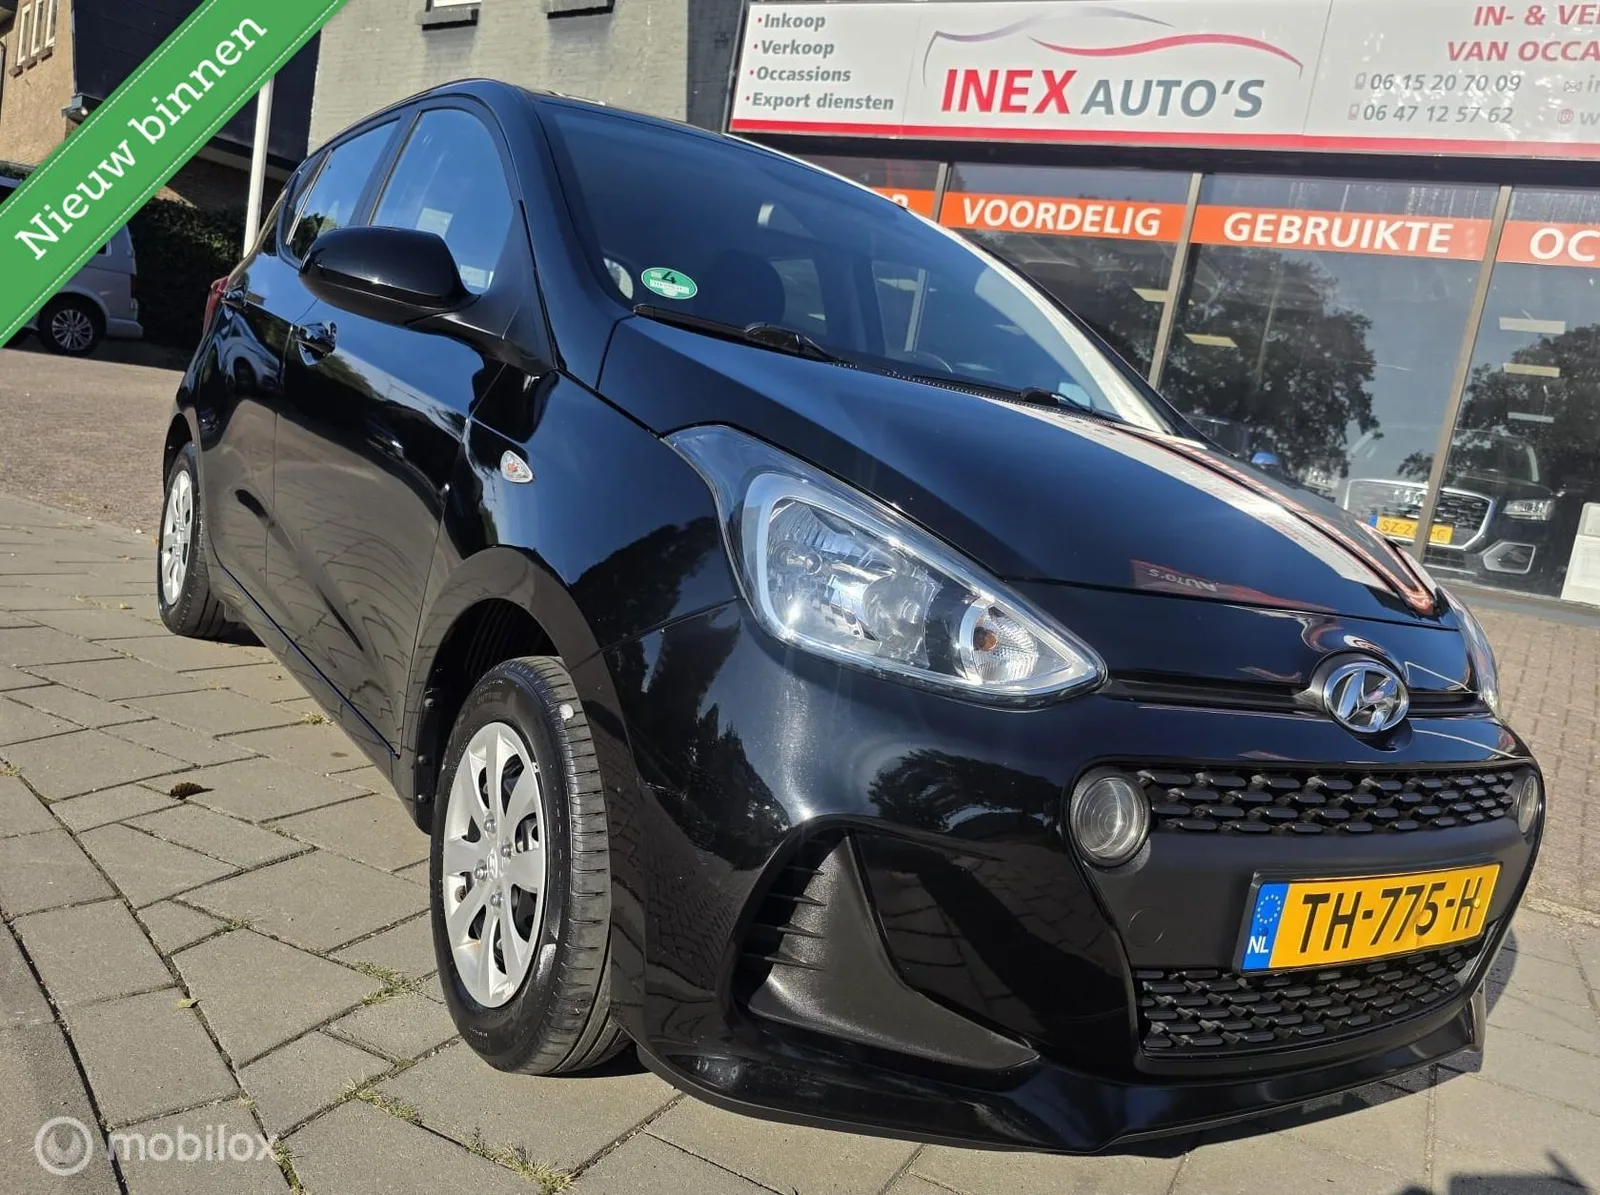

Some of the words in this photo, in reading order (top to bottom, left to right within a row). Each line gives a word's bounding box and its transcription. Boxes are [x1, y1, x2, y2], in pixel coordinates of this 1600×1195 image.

[764, 13, 826, 32] Inkoop
[1473, 6, 1515, 26] IN-
[1524, 5, 1545, 26] &
[1558, 4, 1600, 25] VE
[761, 39, 835, 59] Verkoop
[1447, 41, 1508, 61] VAN
[757, 66, 851, 82] Occassions
[1370, 74, 1394, 90] 06
[1403, 74, 1426, 90] 15
[1431, 75, 1456, 91] 20
[1464, 75, 1489, 91] 70
[1495, 75, 1521, 92] 09
[752, 92, 811, 111] Export
[816, 93, 894, 110] diensten
[941, 69, 1077, 114] INEX
[1363, 105, 1387, 121] 06
[1393, 105, 1419, 122] 47
[1427, 106, 1448, 122] 12
[1455, 107, 1480, 123] 57
[1488, 107, 1513, 123] 62
[963, 198, 1162, 236] VOORDELIG
[1223, 212, 1453, 254] GEBRUIKTE
[1530, 228, 1600, 261] OC
[661, 270, 677, 284] 4
[1300, 877, 1483, 953] TH-775-H
[1247, 935, 1269, 954] NL
